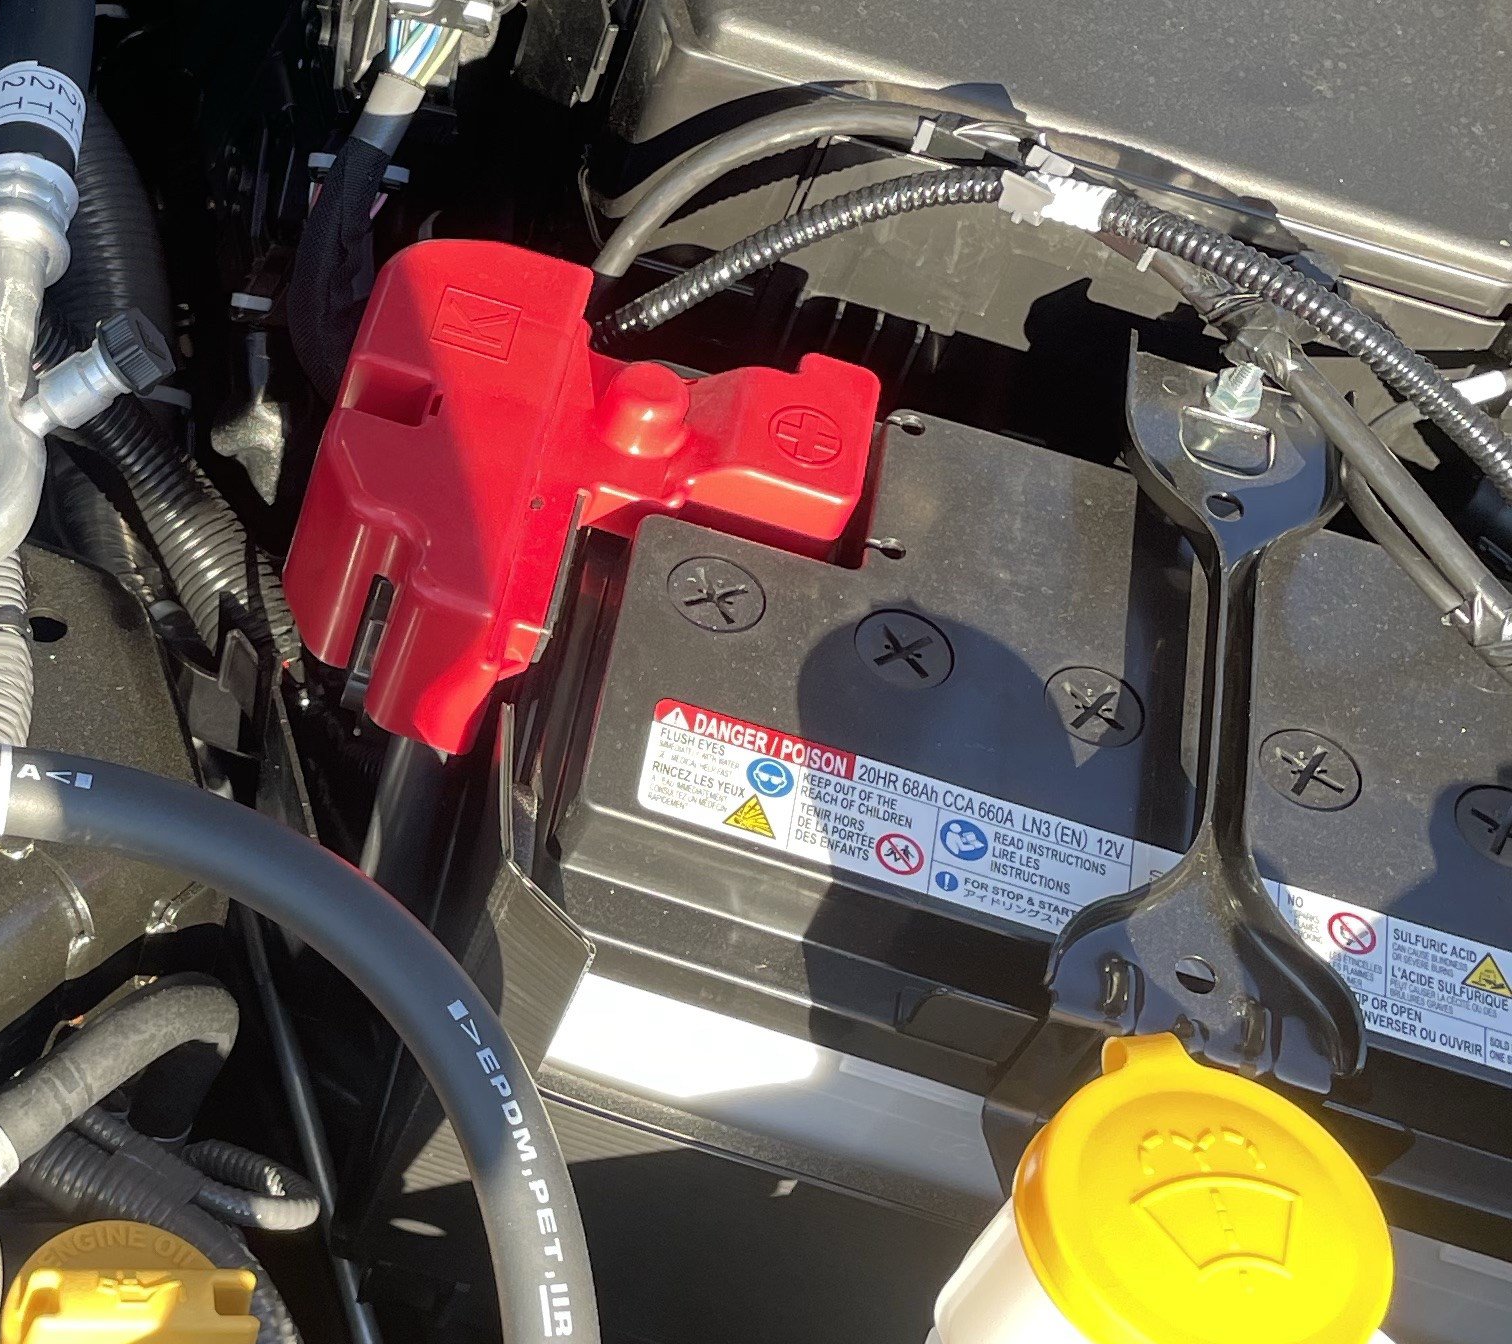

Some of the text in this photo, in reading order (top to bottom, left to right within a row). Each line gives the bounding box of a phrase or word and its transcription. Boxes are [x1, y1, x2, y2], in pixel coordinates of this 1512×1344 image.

[660, 727, 726, 756] FLUSH EYES
[694, 712, 768, 753] DANGER
[779, 739, 848, 777] POISON
[652, 760, 692, 782] RINCEZ
[693, 773, 714, 789] LES
[717, 779, 746, 798] YEUX
[803, 772, 899, 811] KEEP OUT OF THE
[797, 815, 813, 830] DE
[815, 820, 829, 835] LA
[800, 802, 865, 832] TENIR HORS
[801, 785, 913, 830] REACH OF CHILDREN
[858, 764, 1126, 860] 20HR 68Ah CCA 660A LN3 (EN) 12V
[795, 828, 870, 862] DES ENFANTS
[992, 846, 1041, 871] LIRE LES
[993, 831, 1107, 876] READ INSTRUCTIONS
[989, 859, 1071, 896] INSTRUCTIONS
[964, 877, 1077, 919] FOR STOP & START
[1287, 893, 1304, 908] NO
[1391, 942, 1406, 954] CAN
[1393, 928, 1477, 963] SULFURIC ACID
[1391, 965, 1435, 989] L'ACIDE
[1437, 979, 1509, 1011] SULFURIQUE
[1371, 997, 1422, 1023] OR OPEN
[1419, 1027, 1437, 1043] OU
[1439, 1033, 1483, 1057] OUVRIR
[41, 1224, 199, 1268] ENGINE OIL
